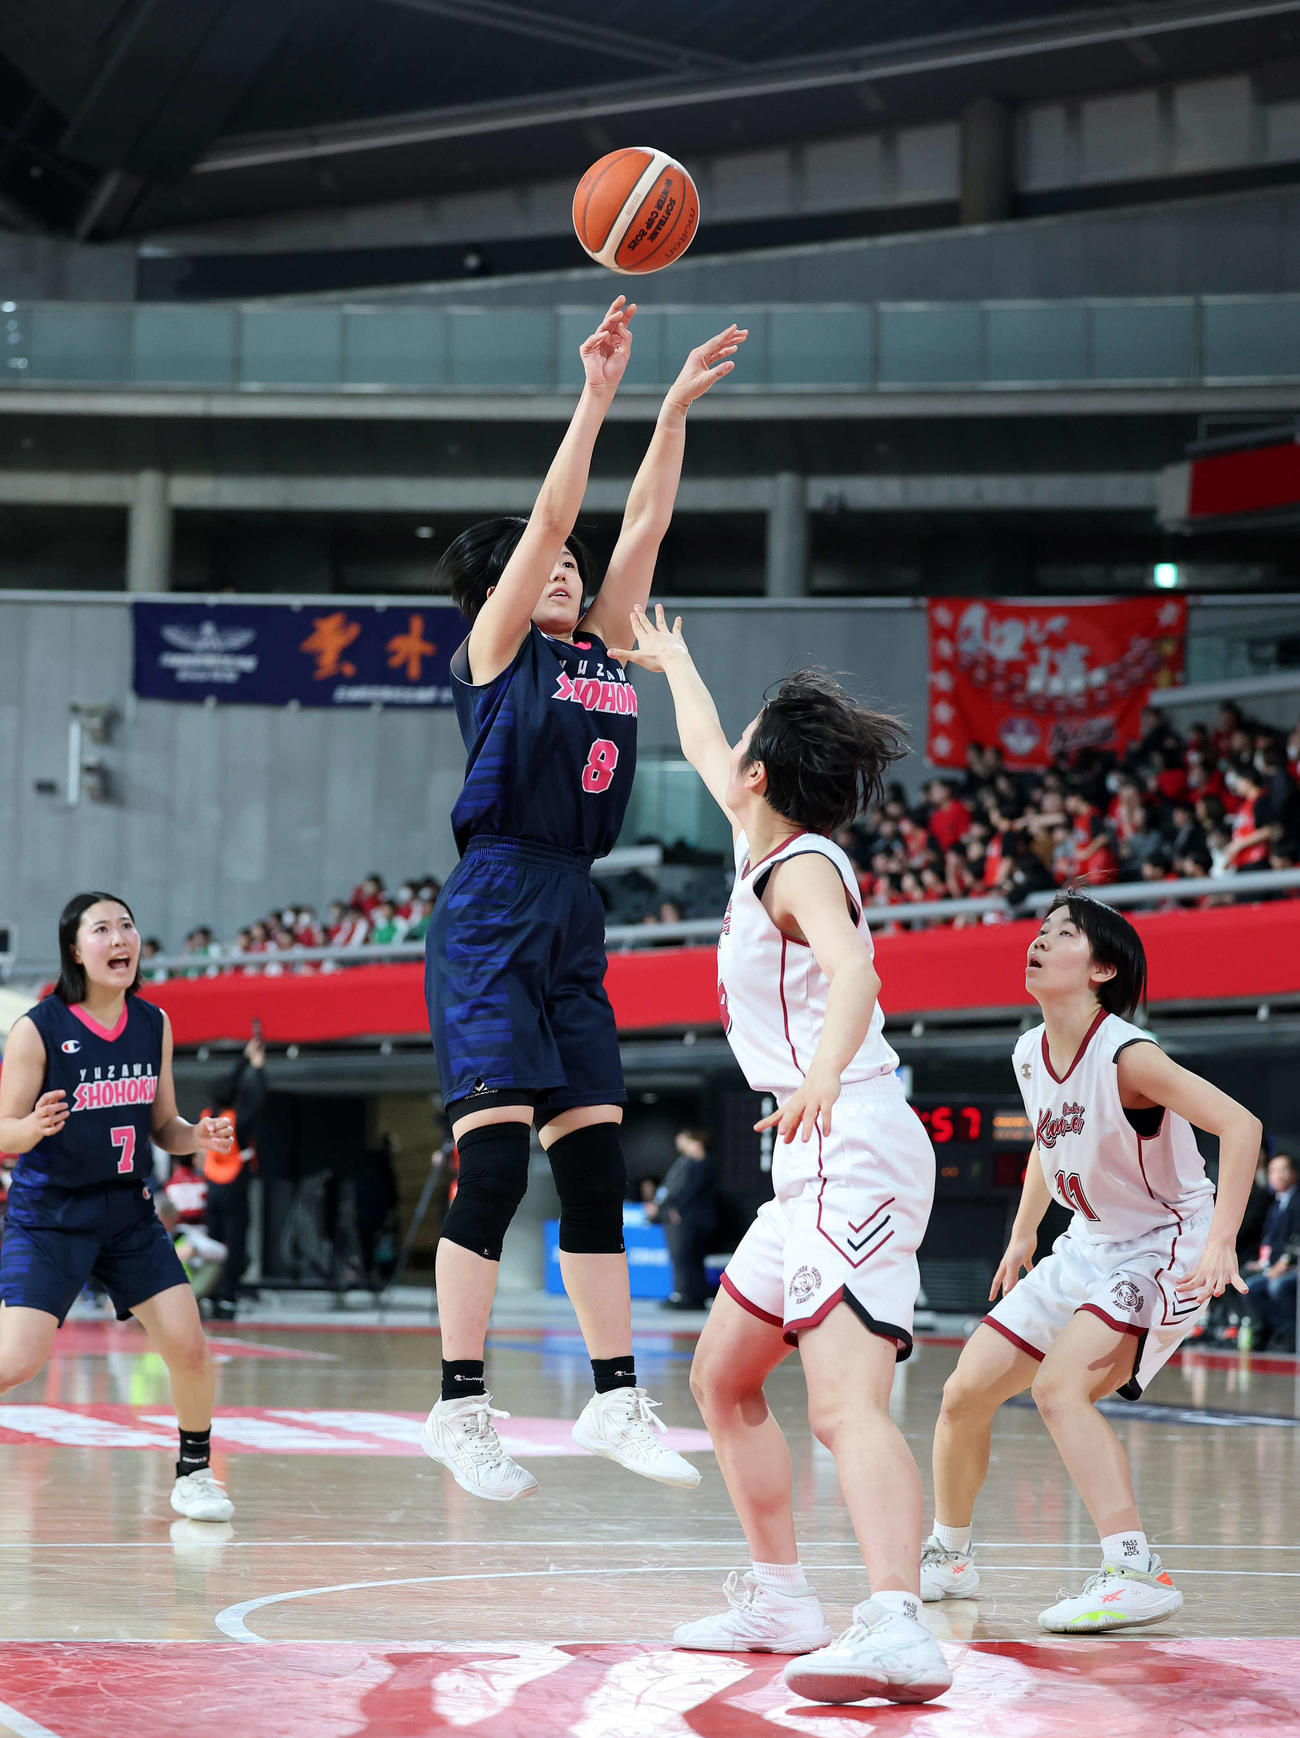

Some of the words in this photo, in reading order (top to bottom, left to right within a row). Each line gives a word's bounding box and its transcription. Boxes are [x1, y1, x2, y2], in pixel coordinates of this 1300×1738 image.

[656, 178, 673, 211] WINTER
[644, 210, 659, 230] CUP
[647, 197, 677, 242] SOFTBANK
[581, 738, 619, 793] 8
[79, 1063, 153, 1081] YUZAWA
[71, 1075, 158, 1112] SHOHOKU
[110, 1125, 136, 1174] 7
[1055, 1169, 1101, 1222] 11
